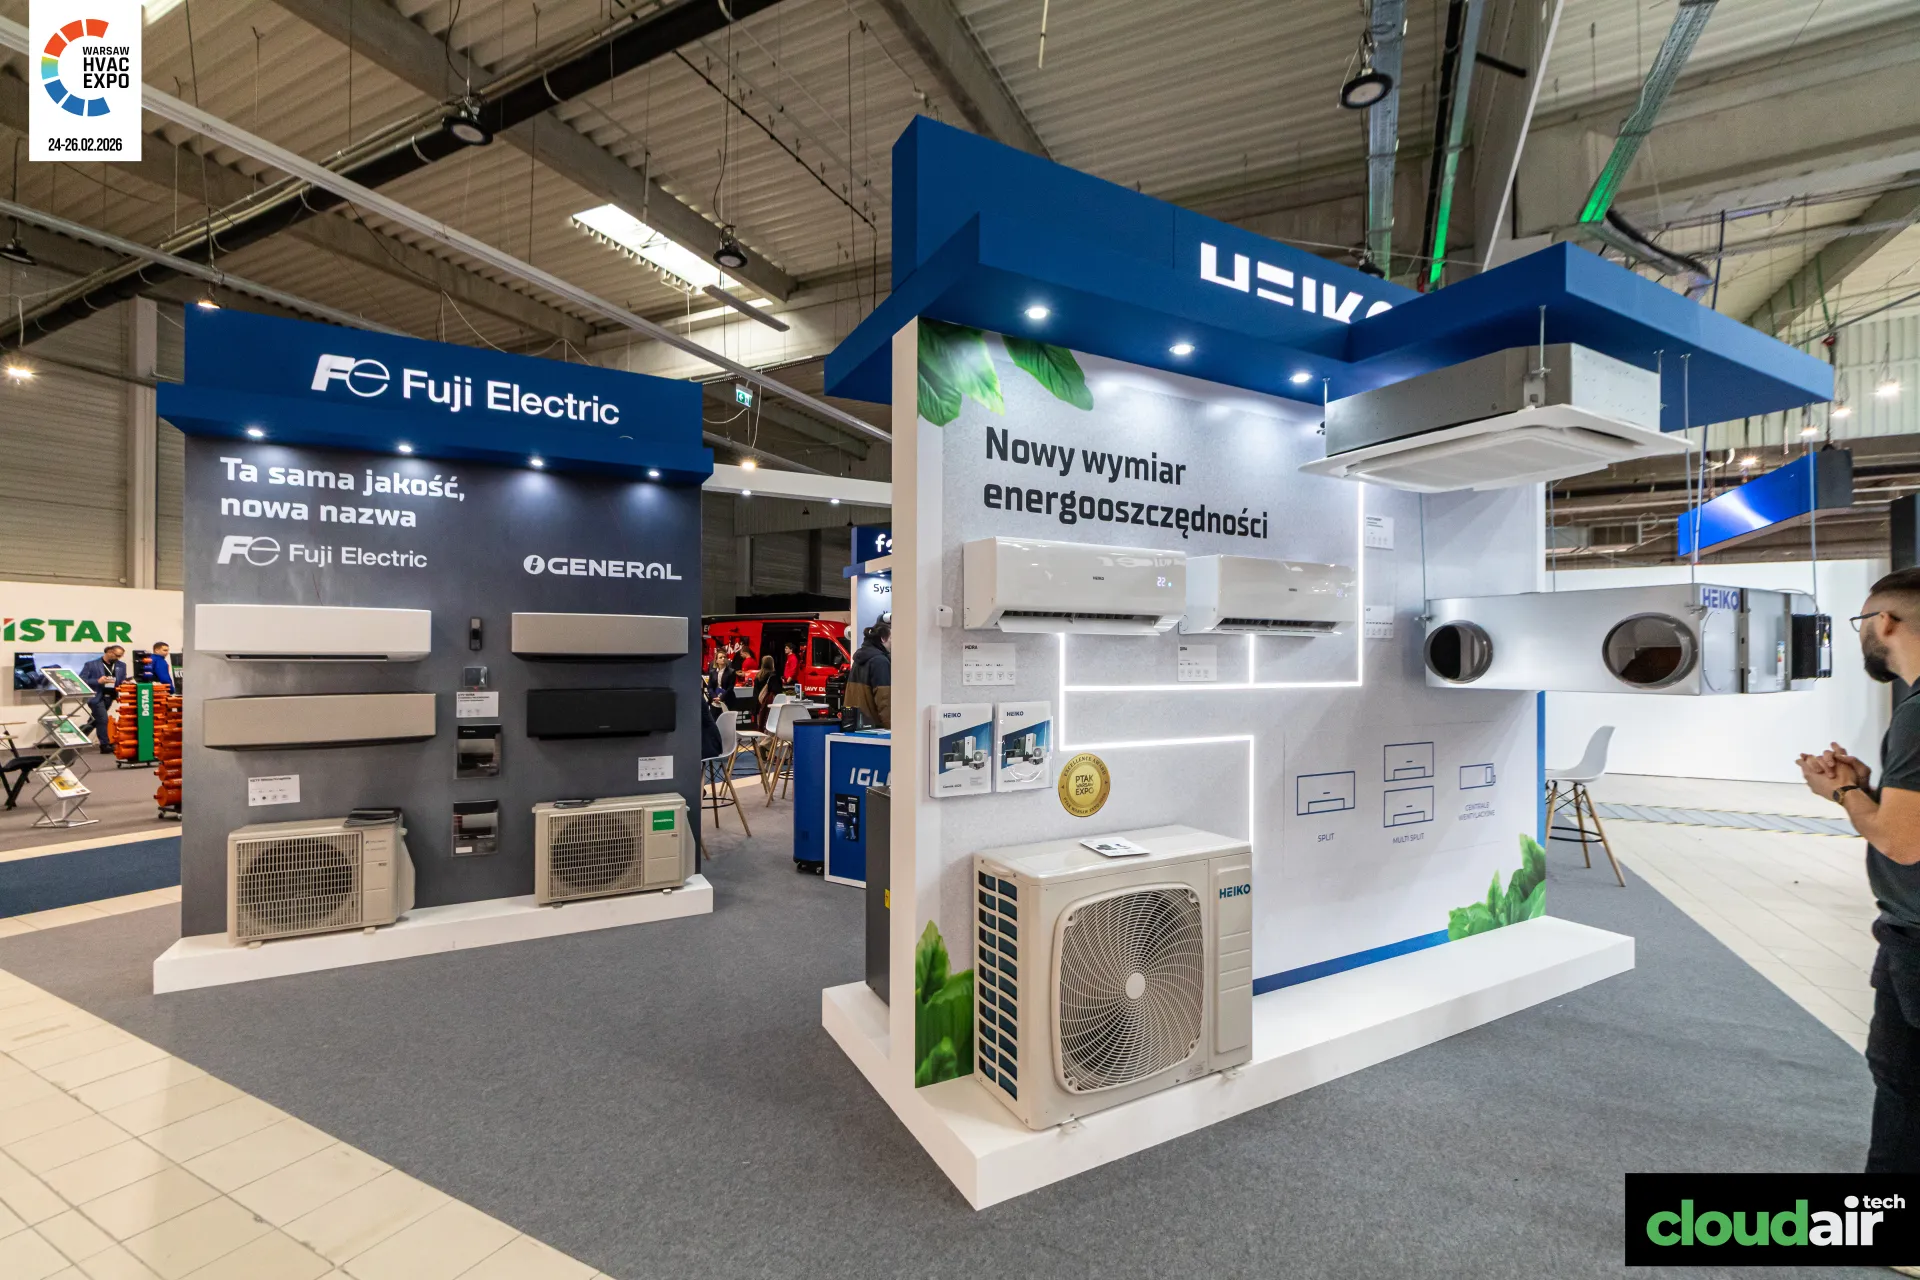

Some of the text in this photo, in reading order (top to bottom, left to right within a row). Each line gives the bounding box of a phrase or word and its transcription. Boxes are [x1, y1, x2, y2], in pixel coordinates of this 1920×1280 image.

[403, 368, 471, 413] Fuji
[486, 380, 620, 425] Electric
[986, 426, 1186, 485] Nowy wymiar
[220, 456, 465, 502] Ta sama jakość,
[221, 497, 416, 527] nowa nazwa
[984, 483, 1268, 539] energooszczędności
[289, 543, 332, 568] Fuji
[341, 547, 428, 568] Electric
[548, 557, 682, 580] GENERAL
[1702, 588, 1740, 611] HEIKO
[1064, 756, 1107, 777] EXCELLENCE AWARD
[1075, 774, 1094, 783] PTAK
[1075, 788, 1095, 796] EXPO
[1317, 832, 1335, 843] SPLIT
[1392, 832, 1425, 844] MULTI SPLIT
[1219, 883, 1251, 900] HEIKO
